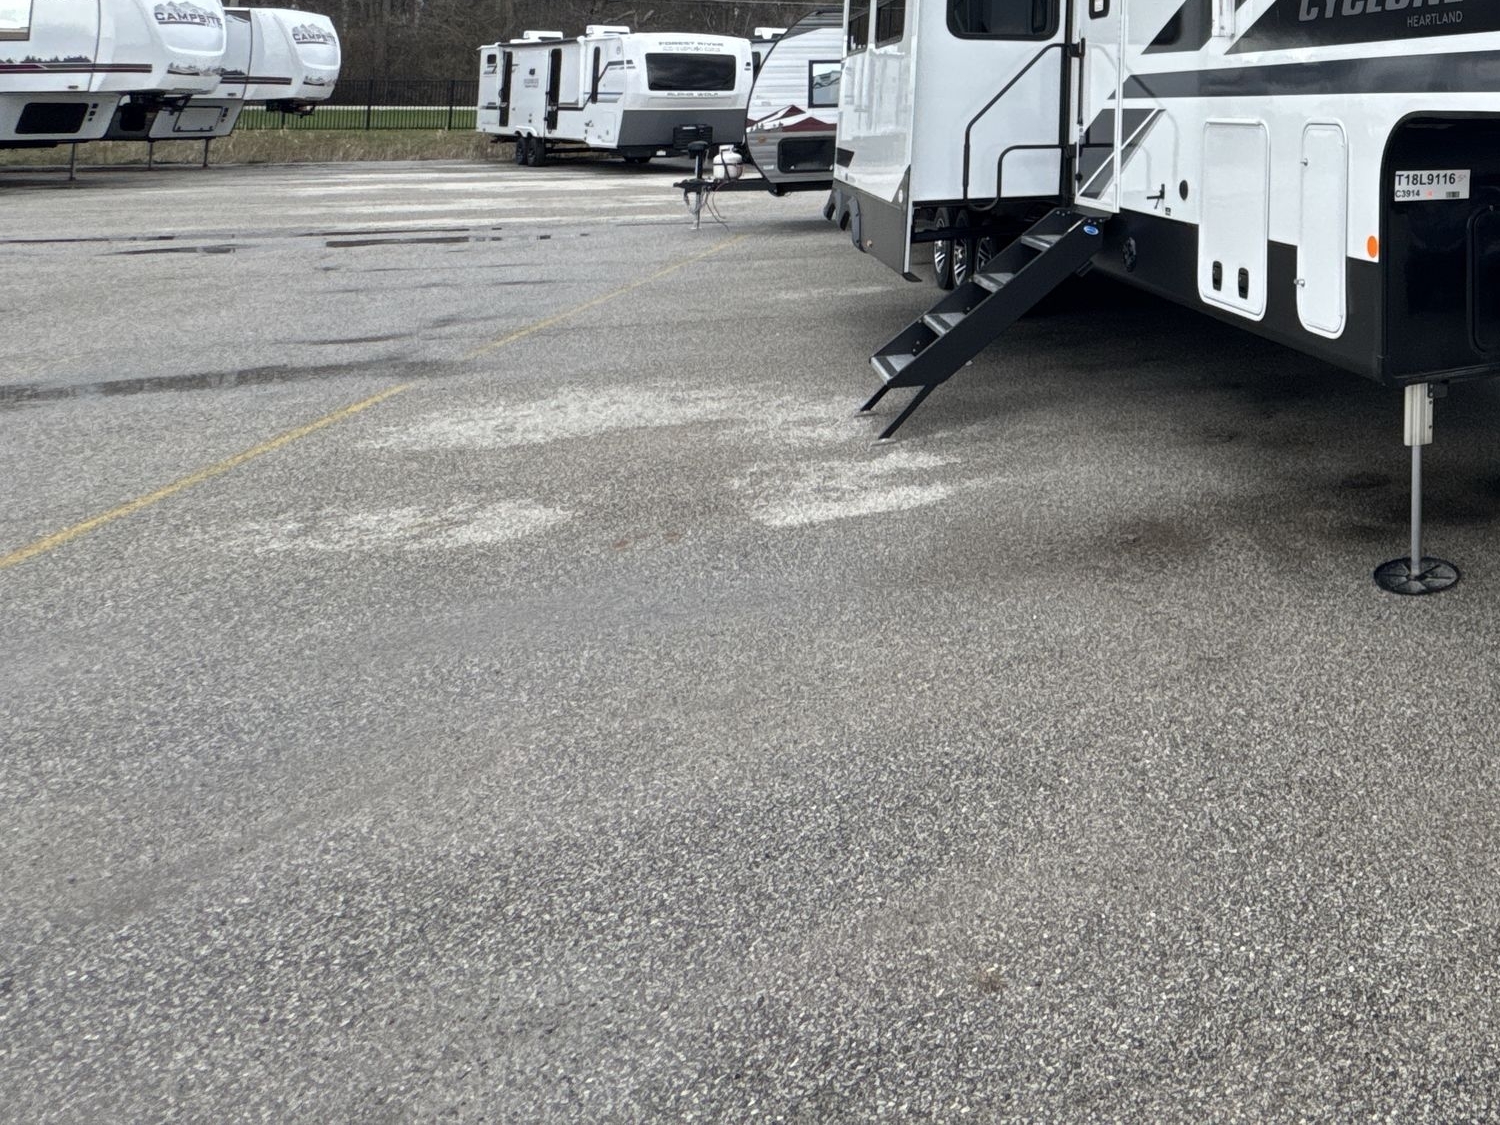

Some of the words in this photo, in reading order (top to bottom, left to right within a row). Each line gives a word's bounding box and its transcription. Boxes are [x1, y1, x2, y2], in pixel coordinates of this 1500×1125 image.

[1406, 10, 1463, 28] HEARTLAND
[1396, 172, 1457, 186] T18L9116
[1395, 189, 1421, 198] C3914
